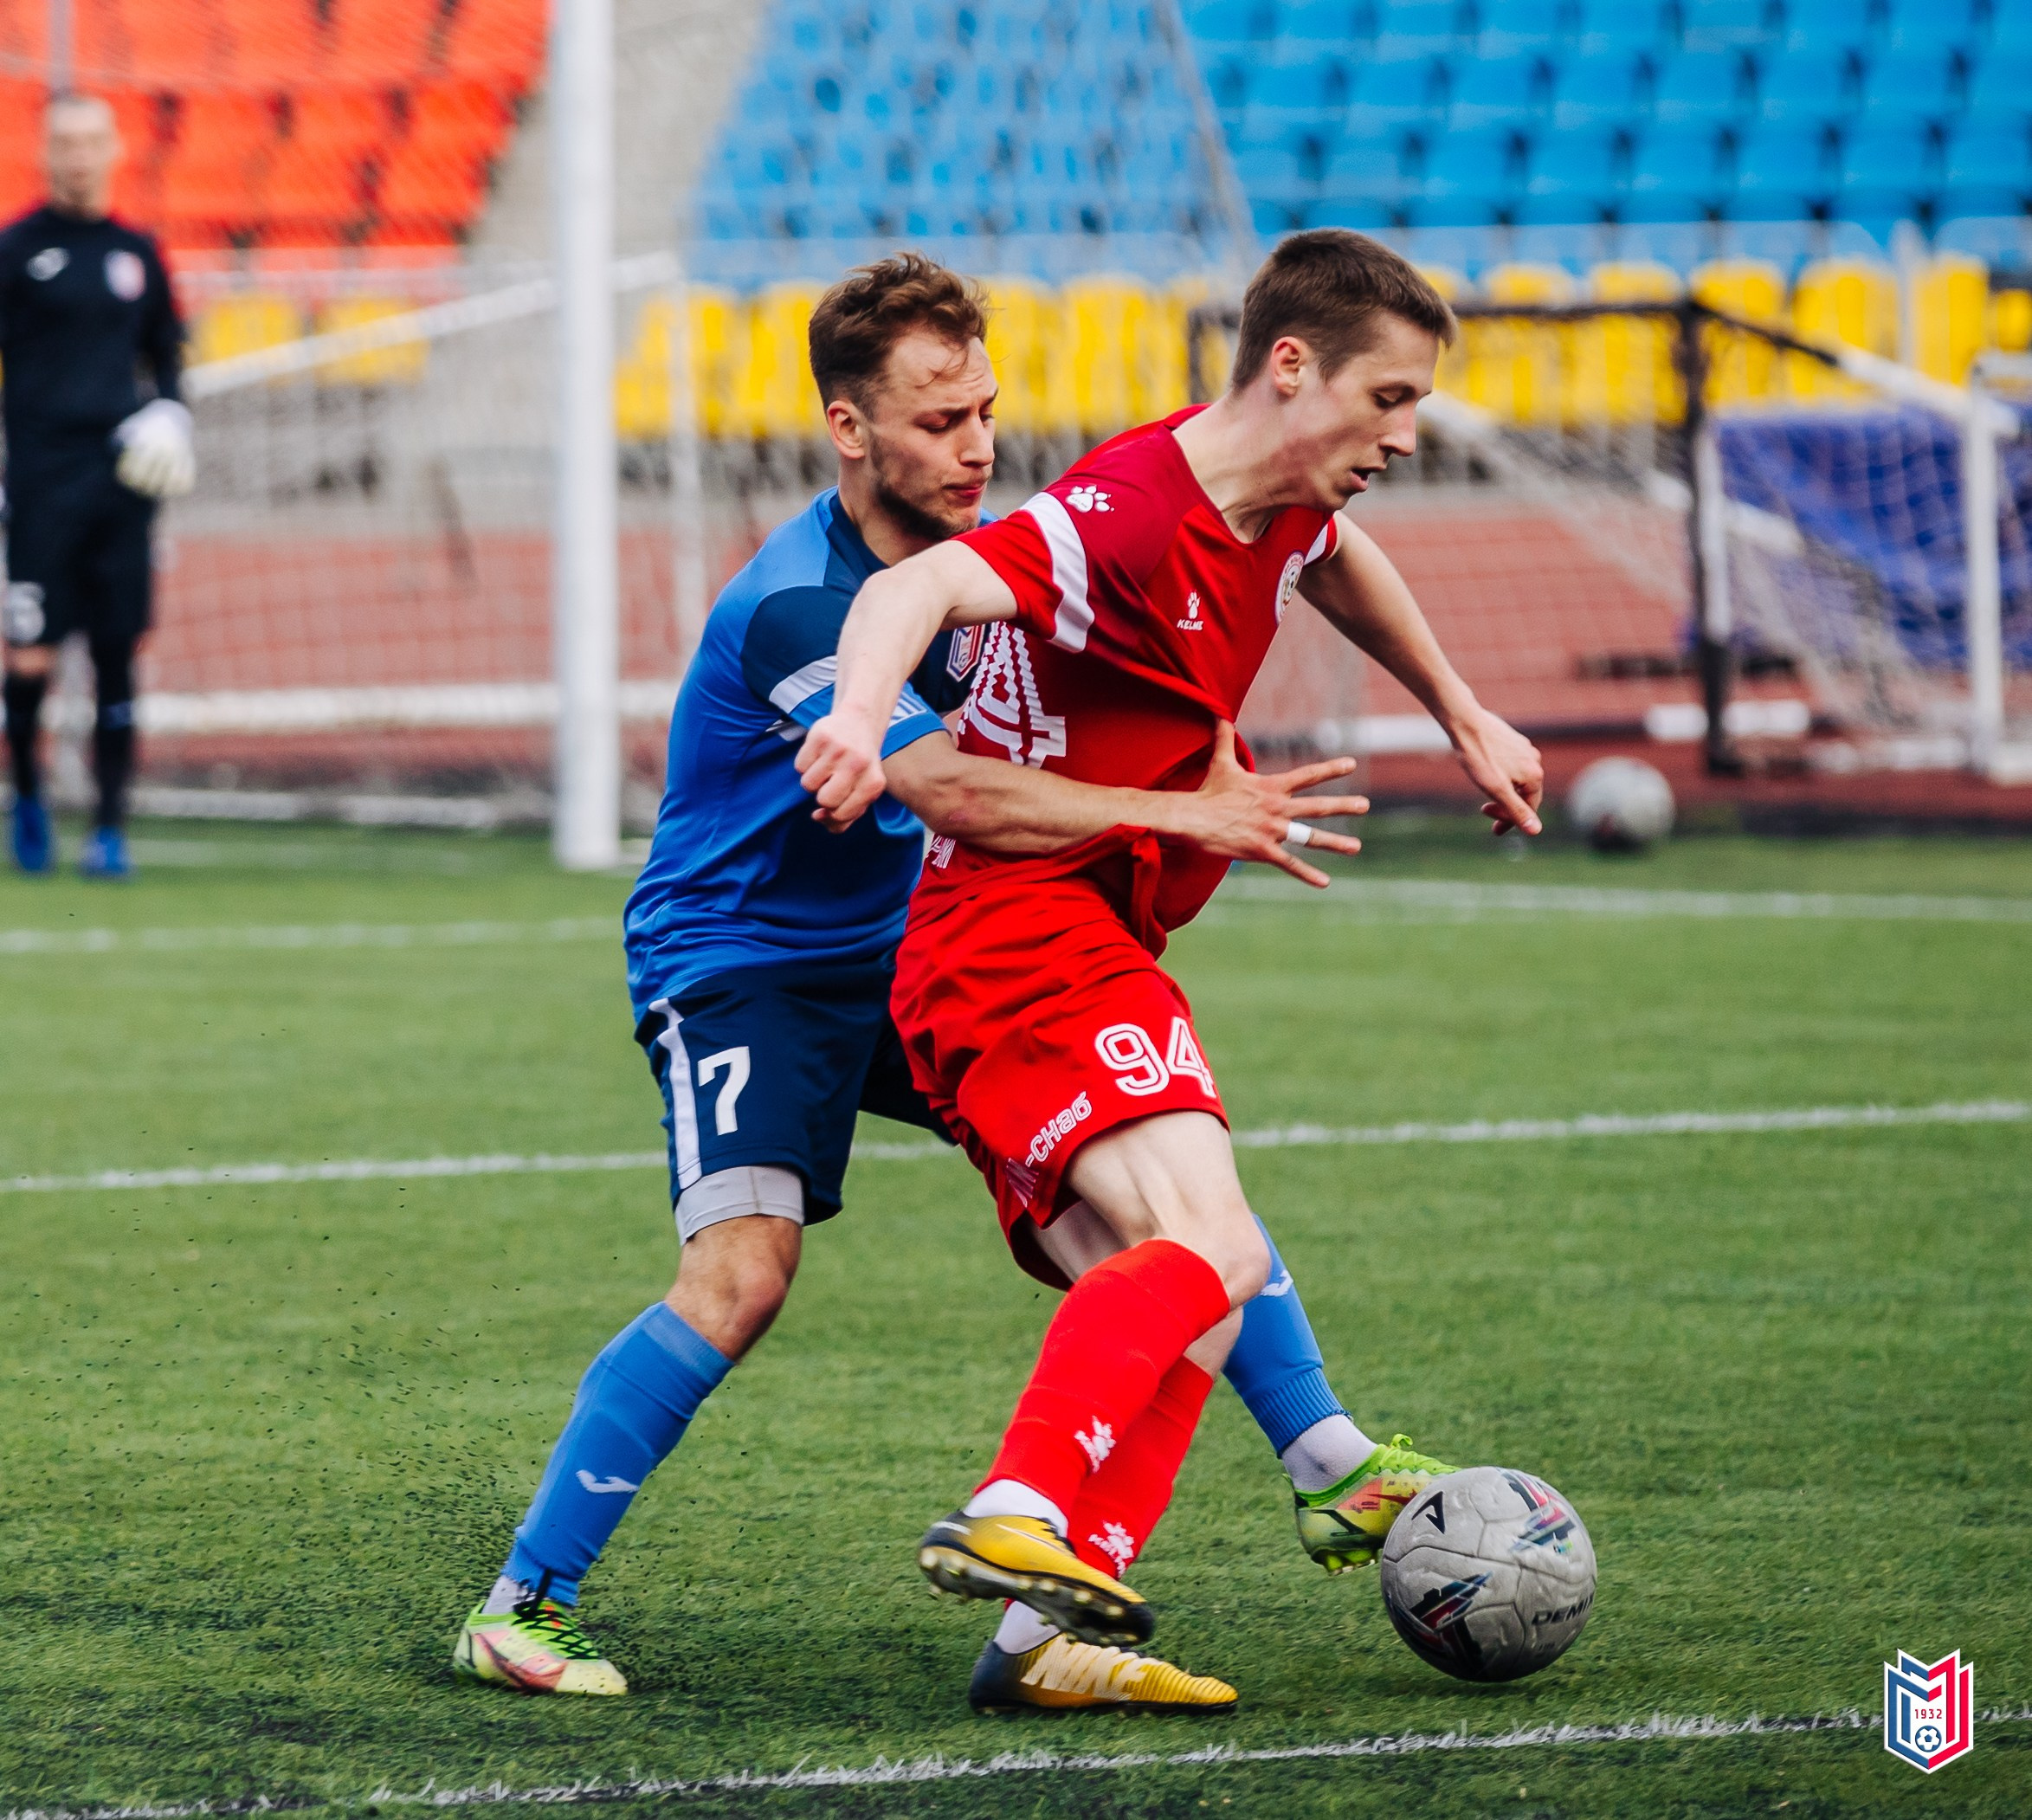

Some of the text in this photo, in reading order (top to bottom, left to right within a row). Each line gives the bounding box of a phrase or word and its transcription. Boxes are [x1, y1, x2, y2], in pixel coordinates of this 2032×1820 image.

[1177, 619, 1203, 630] KELME
[698, 1046, 751, 1136] 7
[1094, 1016, 1216, 1097] 94
